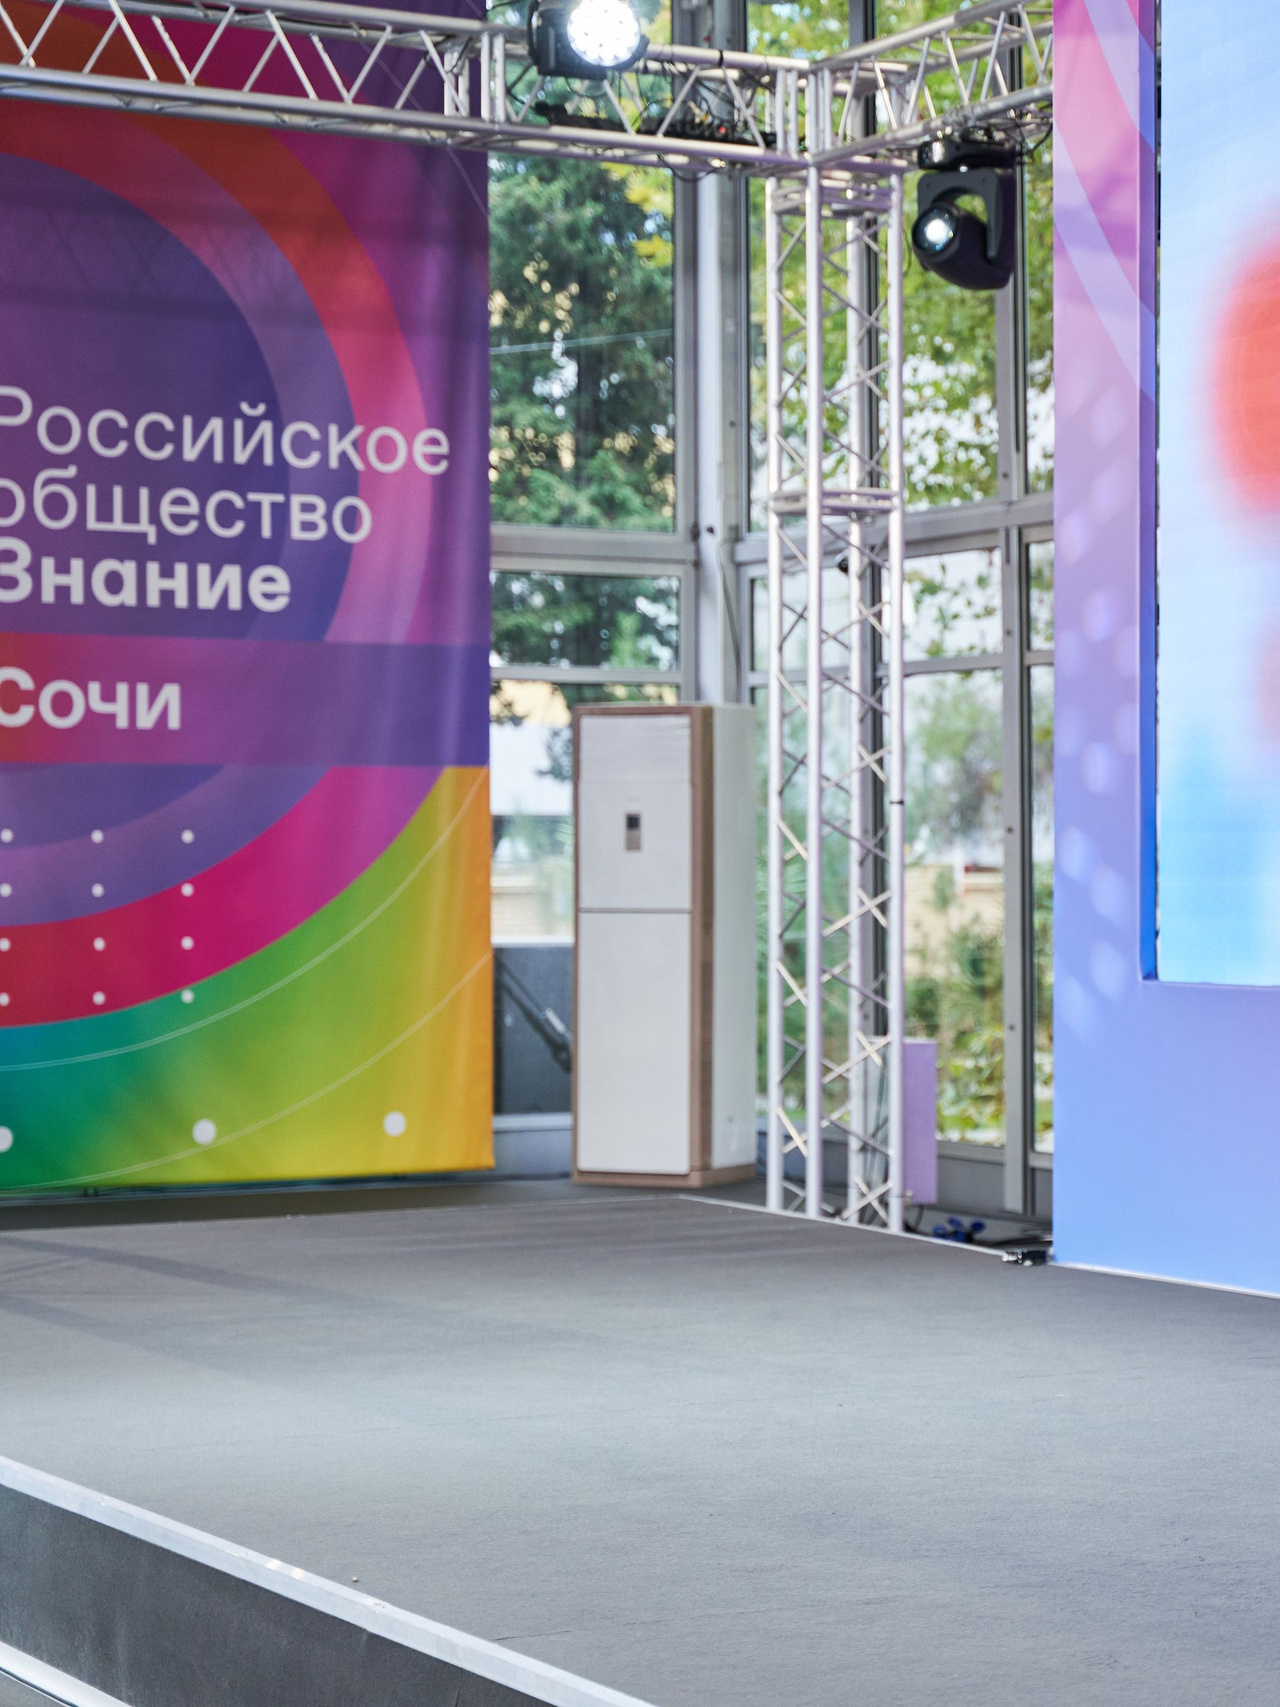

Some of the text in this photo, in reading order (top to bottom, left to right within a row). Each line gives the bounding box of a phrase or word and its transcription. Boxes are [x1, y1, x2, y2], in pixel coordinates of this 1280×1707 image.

[0, 464, 373, 545] общество
[0, 535, 291, 612] Знание
[0, 666, 182, 730] Сочи
